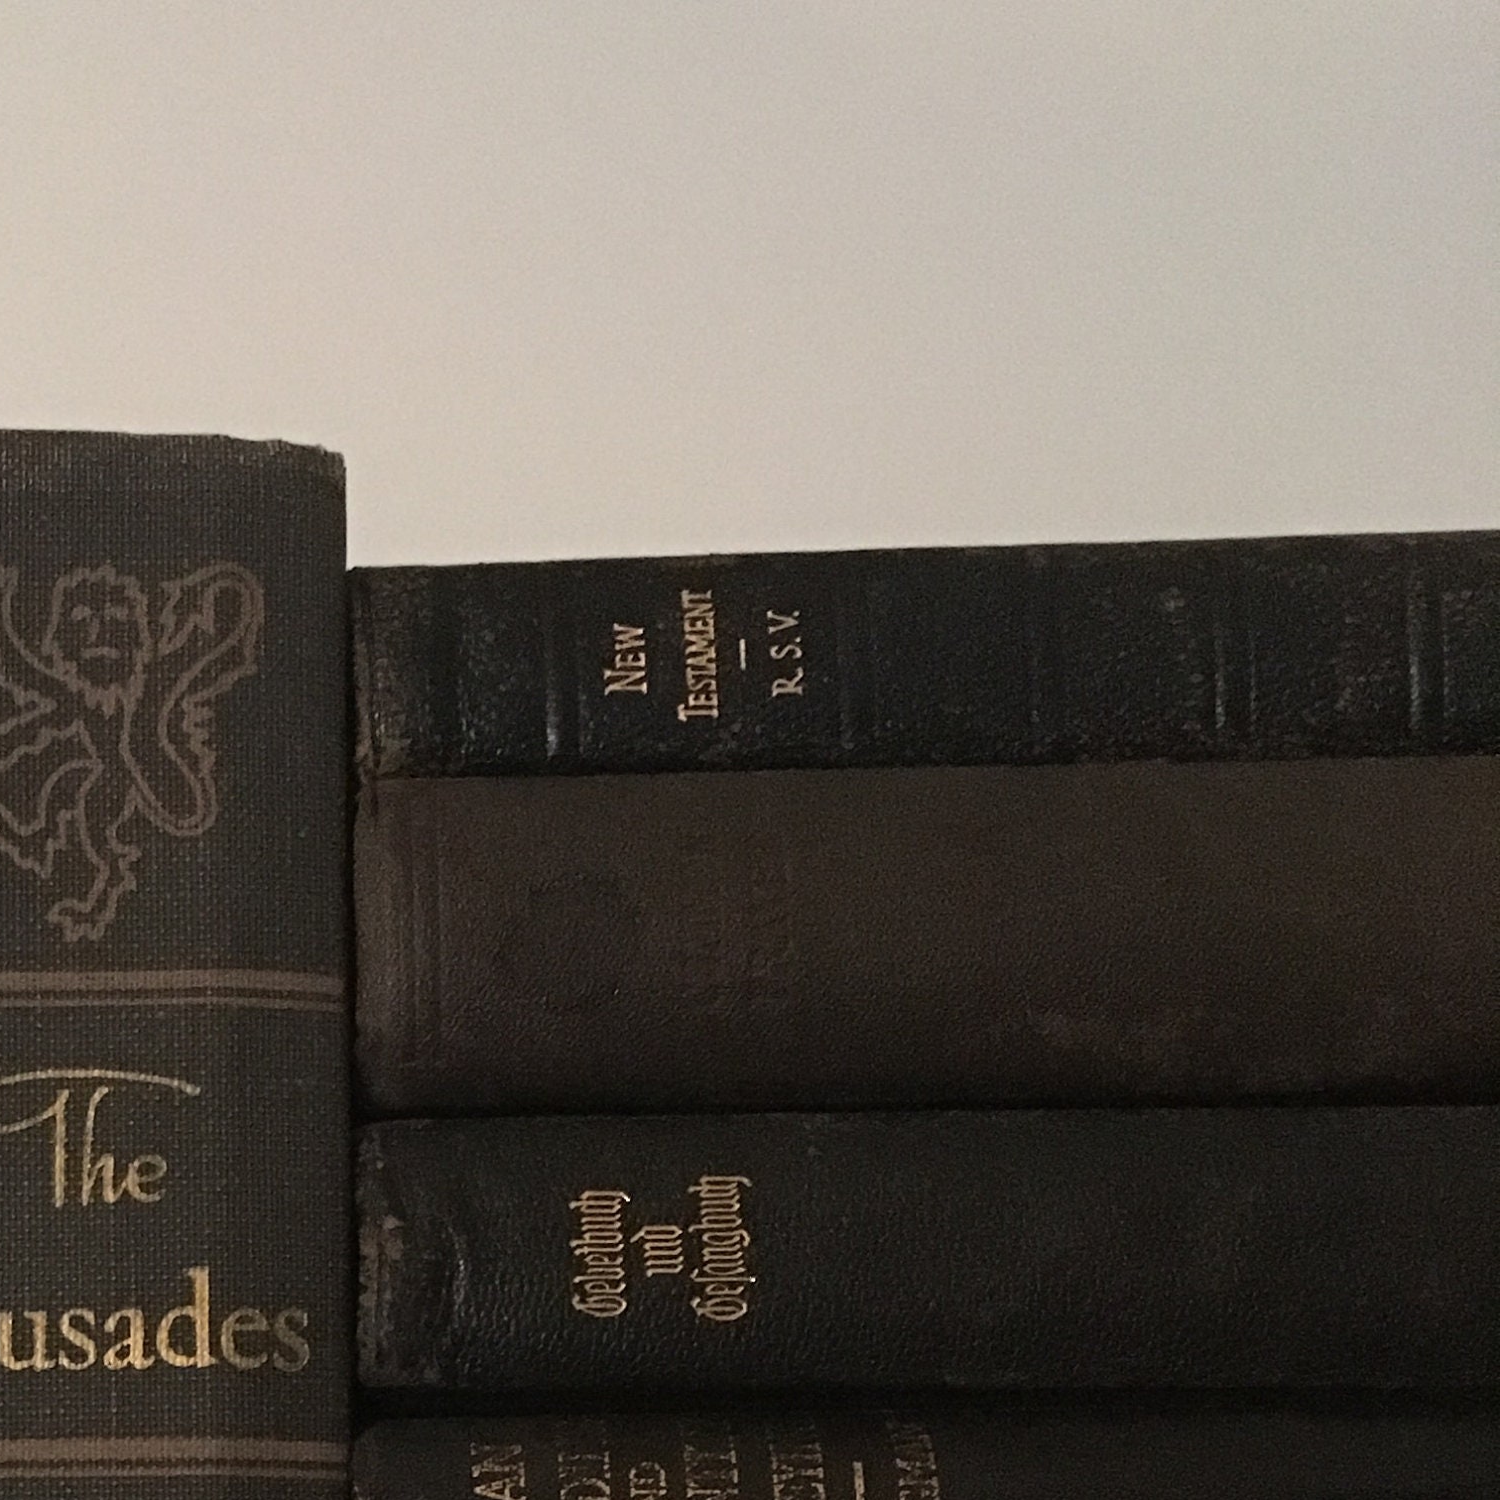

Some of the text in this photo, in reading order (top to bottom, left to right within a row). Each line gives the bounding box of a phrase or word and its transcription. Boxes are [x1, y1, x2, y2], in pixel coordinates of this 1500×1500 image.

[603, 622, 648, 695] NEW
[677, 589, 720, 722] TESTAMENT
[630, 1225, 684, 1278] und
